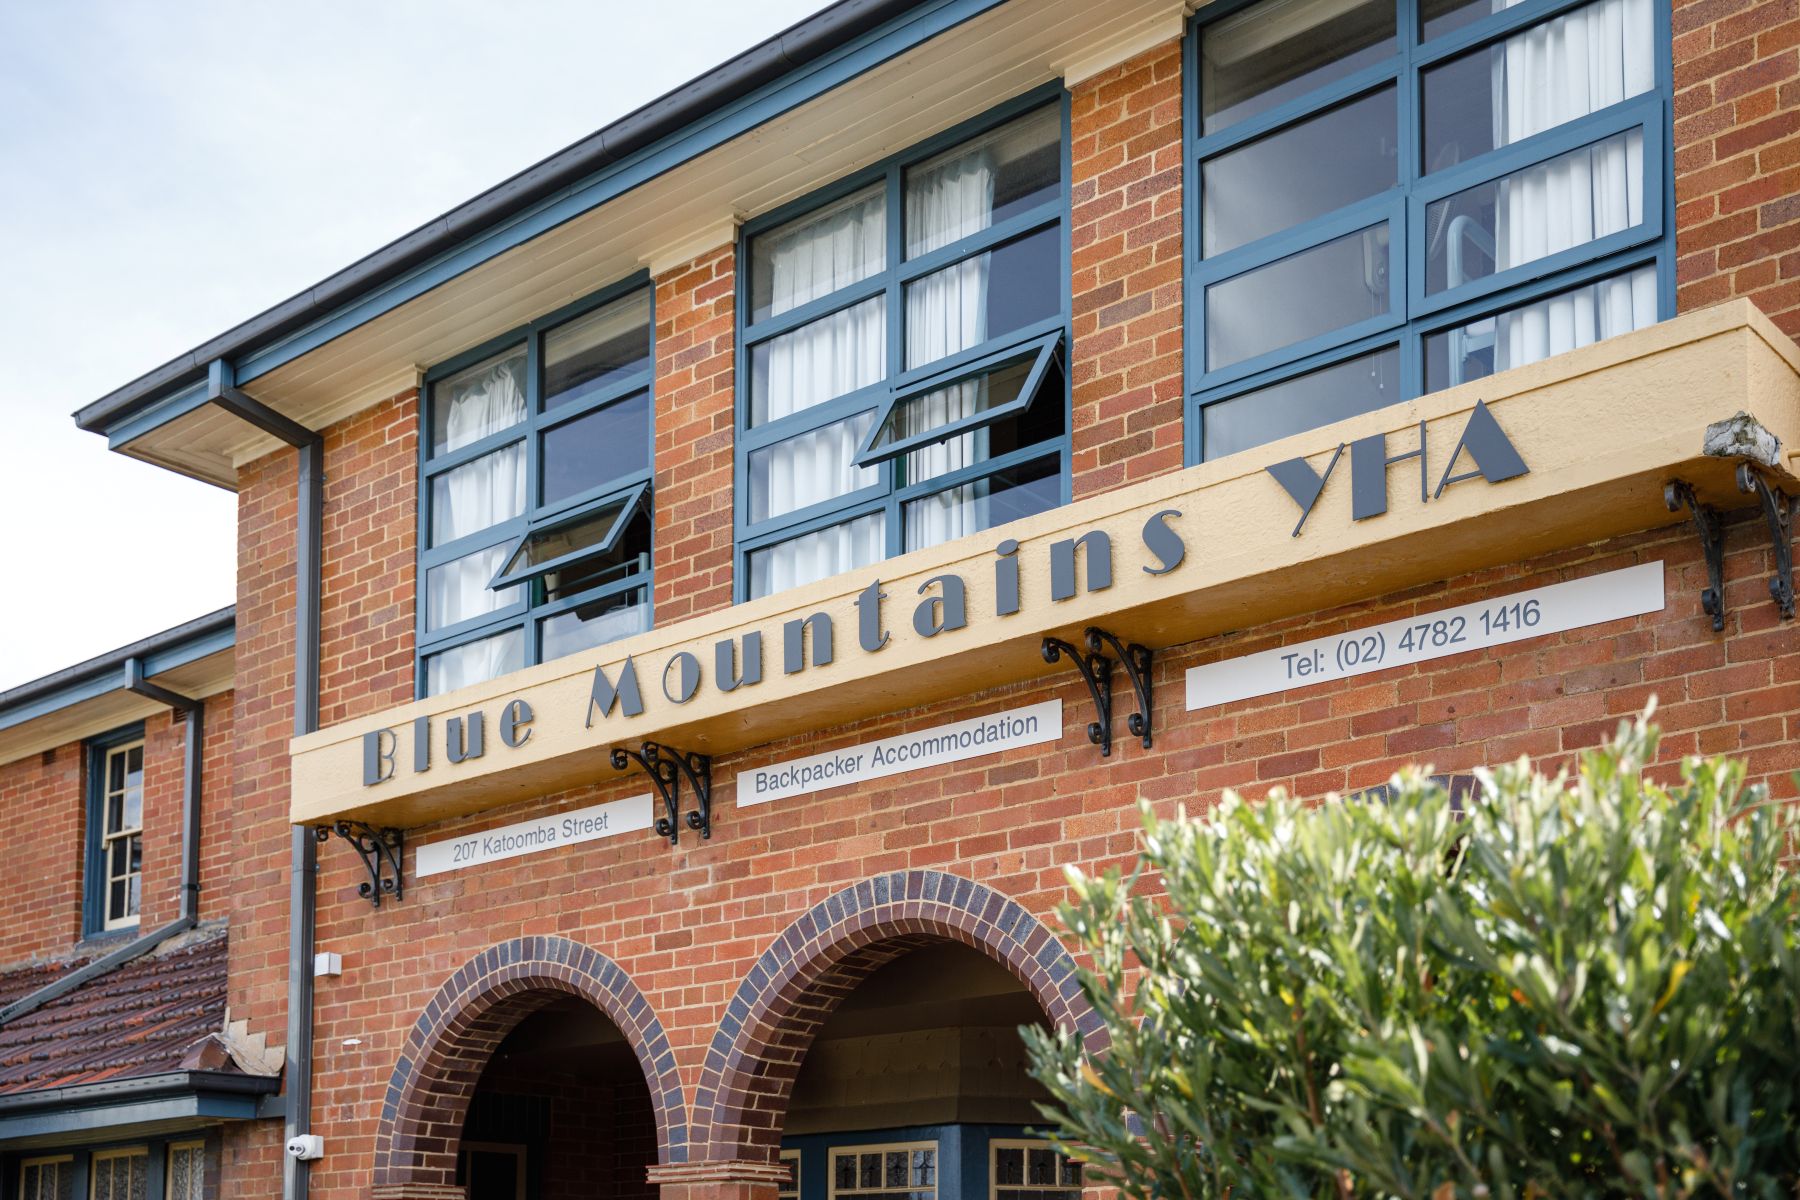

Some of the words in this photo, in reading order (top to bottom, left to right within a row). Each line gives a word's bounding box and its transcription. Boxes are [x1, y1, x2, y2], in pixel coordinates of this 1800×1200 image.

[363, 699, 534, 786] Blue
[586, 509, 1186, 729] Mountains
[1265, 398, 1530, 537] YHA
[1281, 649, 1325, 679] Tel:
[1336, 631, 1386, 673] (02)
[1398, 616, 1466, 654] 4782
[1480, 600, 1541, 636] 1416
[756, 752, 863, 794] Backpacker
[871, 712, 1038, 769] Accommodation
[453, 837, 476, 863] 207
[483, 826, 556, 854] Katoomba
[562, 812, 608, 838] Street
